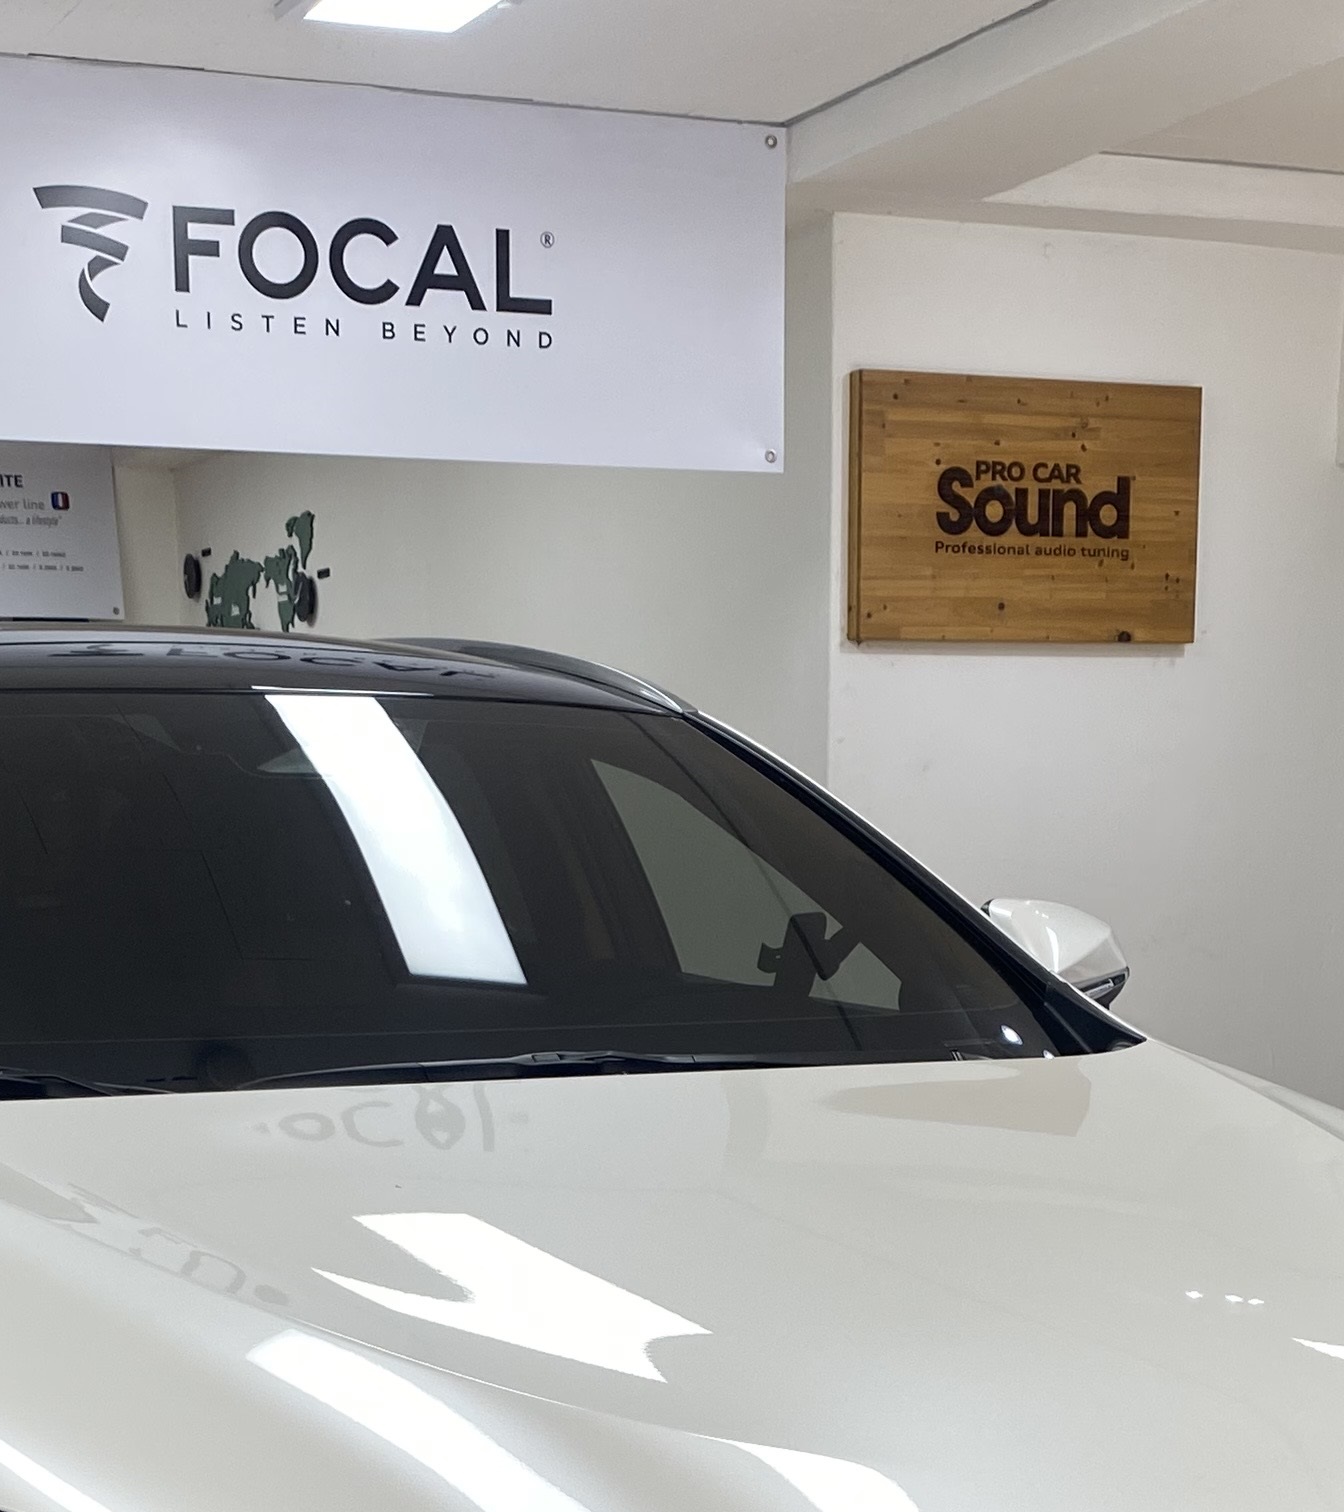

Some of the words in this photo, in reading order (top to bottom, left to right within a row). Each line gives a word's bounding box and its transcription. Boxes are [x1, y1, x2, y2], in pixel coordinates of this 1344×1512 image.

[171, 203, 553, 316] FOCAL
[175, 310, 342, 338] LISTEN
[382, 320, 554, 350] BEYOND
[975, 460, 1026, 483] PRO
[1032, 462, 1083, 485] CAR
[22, 498, 46, 511] line
[935, 466, 1131, 540] Sound
[934, 540, 1031, 557] Professional
[1034, 543, 1077, 558] audio
[1080, 545, 1130, 562] tuning
